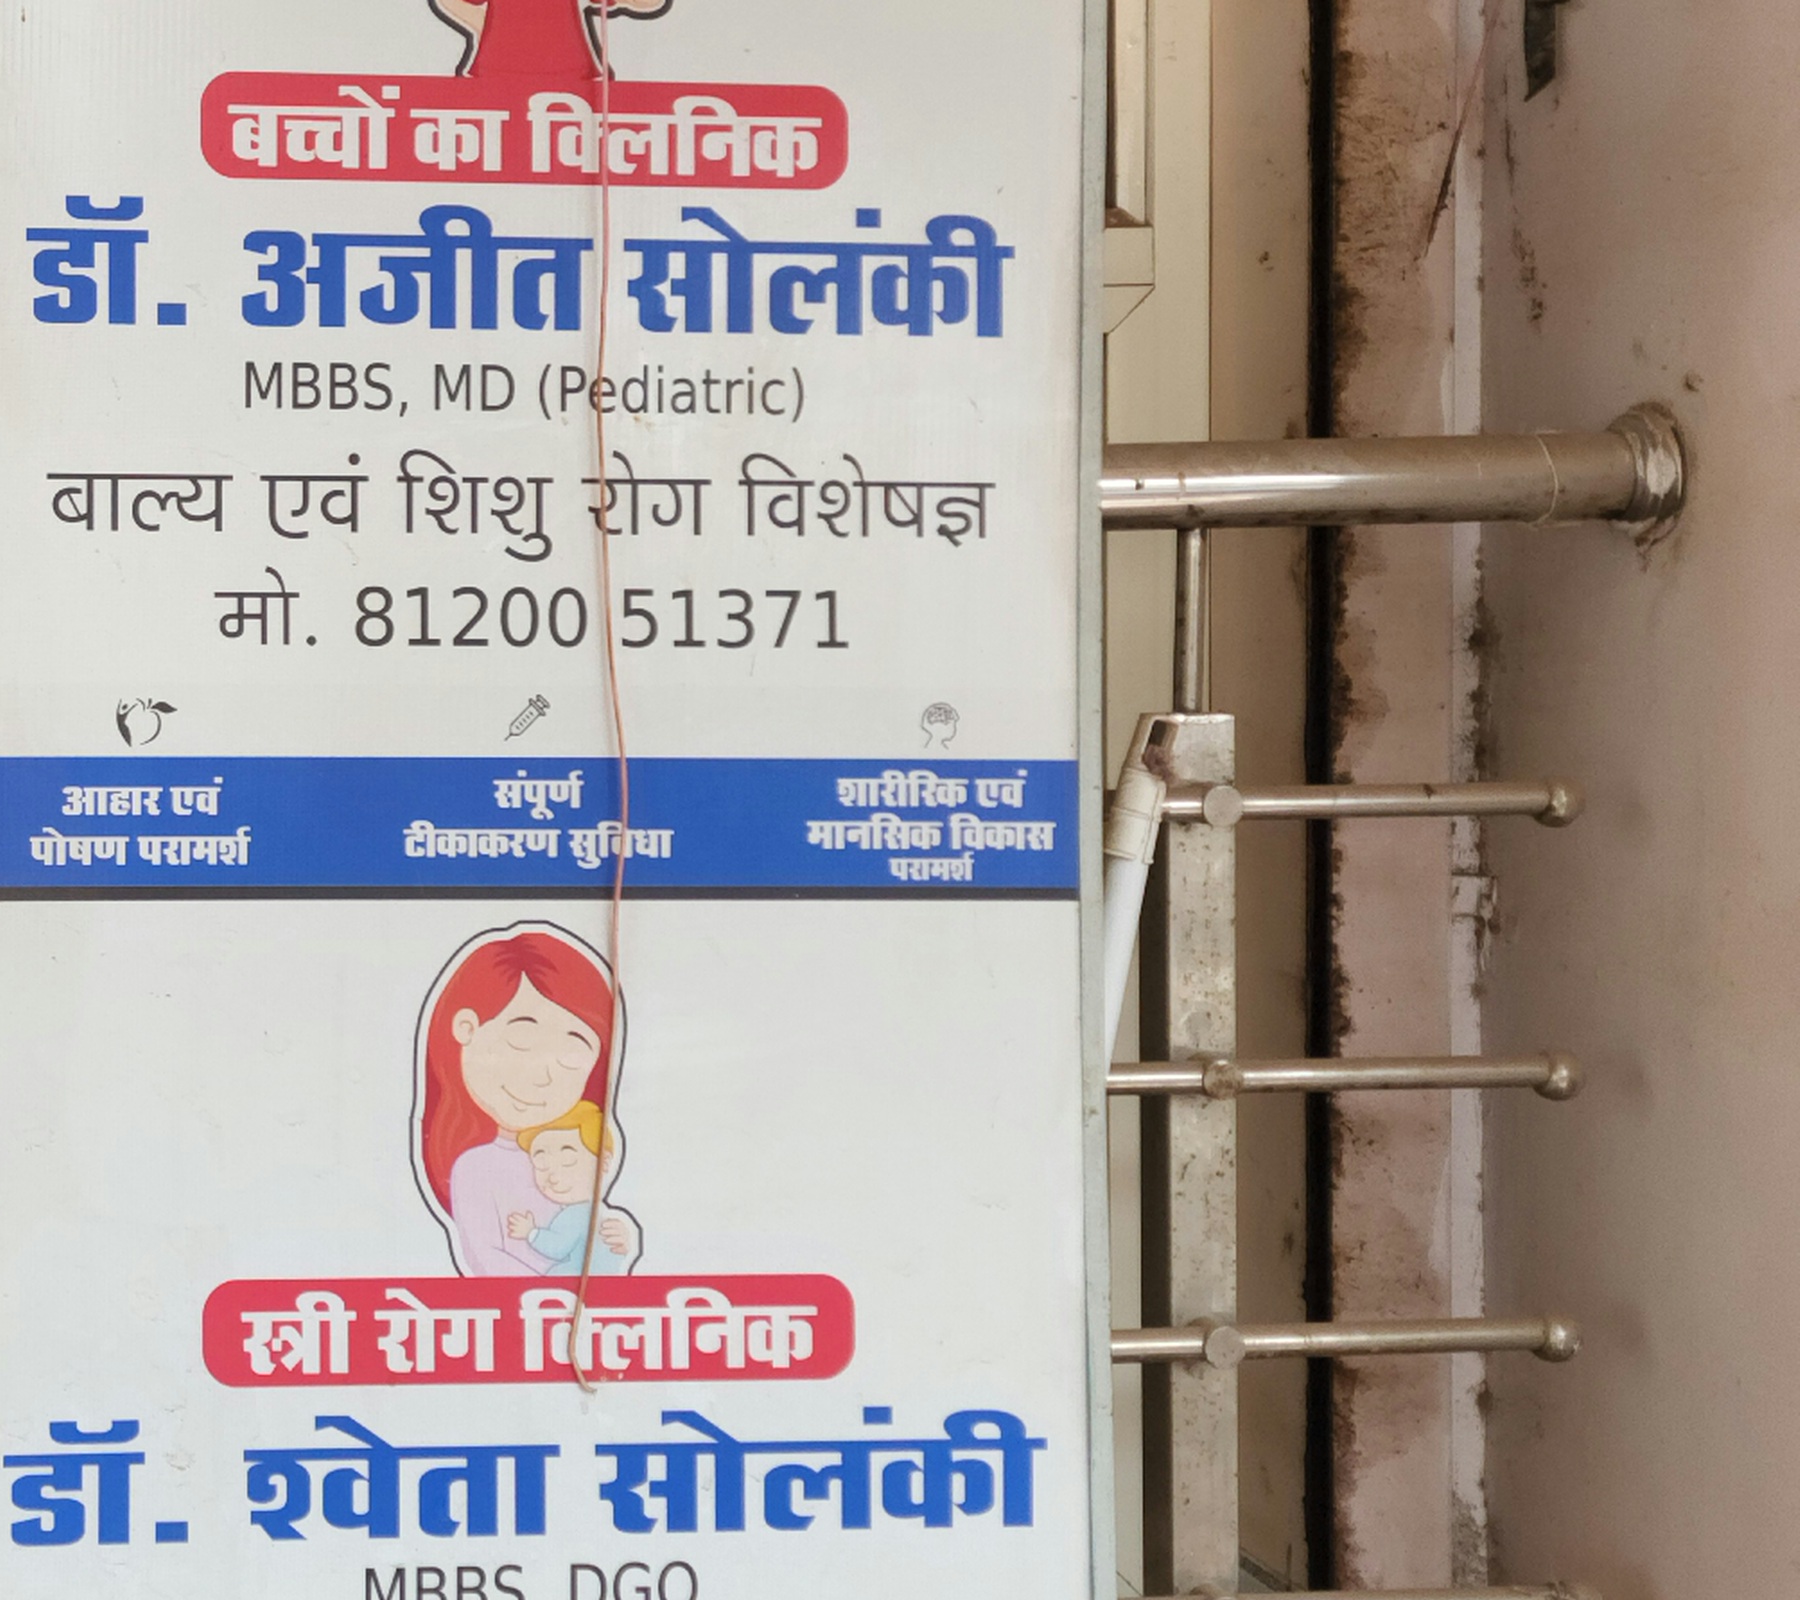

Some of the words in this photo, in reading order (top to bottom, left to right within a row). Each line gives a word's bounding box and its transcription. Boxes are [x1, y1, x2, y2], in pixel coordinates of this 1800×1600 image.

[228, 88, 400, 170] बच्चों
[411, 110, 506, 173] का
[528, 92, 821, 178] क्लिनिक
[26, 196, 187, 325] डॉ.
[241, 204, 593, 332] अजीत
[624, 206, 1015, 338] सोलंकी
[243, 361, 411, 418] MBBS,
[431, 364, 516, 412] MD
[537, 362, 806, 423] (Pediatric)
[47, 472, 233, 533] बाल्य
[260, 452, 368, 540] एवं
[397, 450, 553, 562] शिशु
[588, 451, 709, 537] रोग
[740, 452, 995, 547] विशेषज्ञ
[215, 566, 319, 647] मो.
[353, 585, 589, 648] 81200
[619, 588, 849, 649] 51371
[62, 786, 163, 816] आहार
[170, 776, 223, 816] एवं
[492, 770, 584, 820] संपूर्ण
[837, 770, 968, 808] शारीरिक
[974, 769, 1028, 808] एवं
[30, 827, 130, 866] पोषण
[137, 826, 251, 866] परामर्श
[403, 820, 561, 859] टीकाकरण
[569, 821, 674, 869] सुविधा
[806, 813, 943, 850] मानसिक
[950, 813, 1056, 851] विकास
[890, 851, 975, 881] परामर्श
[242, 1290, 356, 1375] स्त्री
[375, 1288, 496, 1373] रोग
[519, 1286, 818, 1380] क्लिनिक
[3, 1418, 190, 1547] डॉ.
[244, 1415, 561, 1542] श्वेता
[594, 1406, 1048, 1538] सोलंकी
